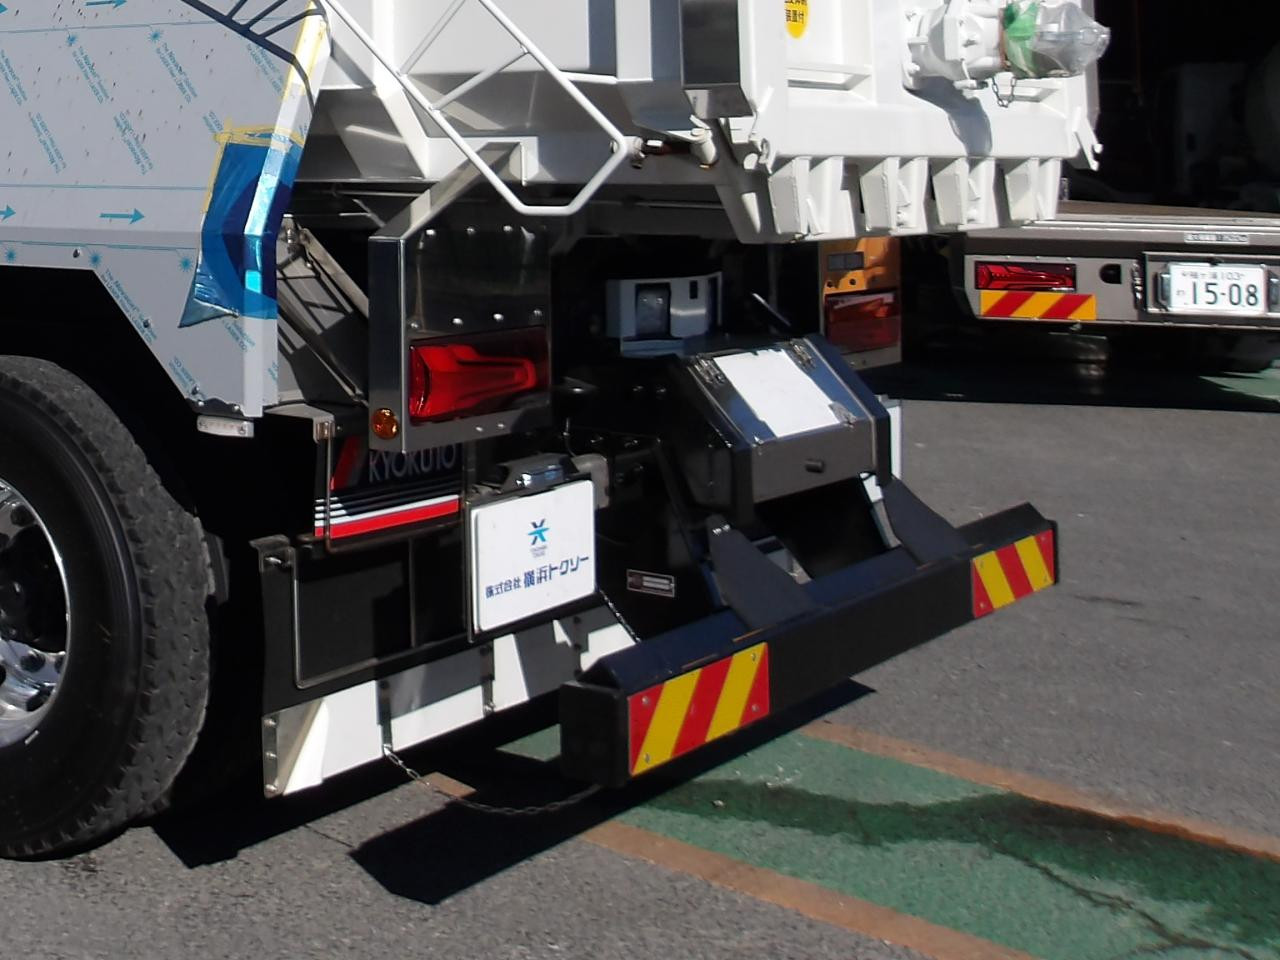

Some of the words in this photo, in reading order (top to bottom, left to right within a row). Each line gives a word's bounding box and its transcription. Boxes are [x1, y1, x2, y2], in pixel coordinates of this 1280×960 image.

[485, 577, 521, 599] 株式会社
[523, 556, 589, 589] 横浜トクソー
